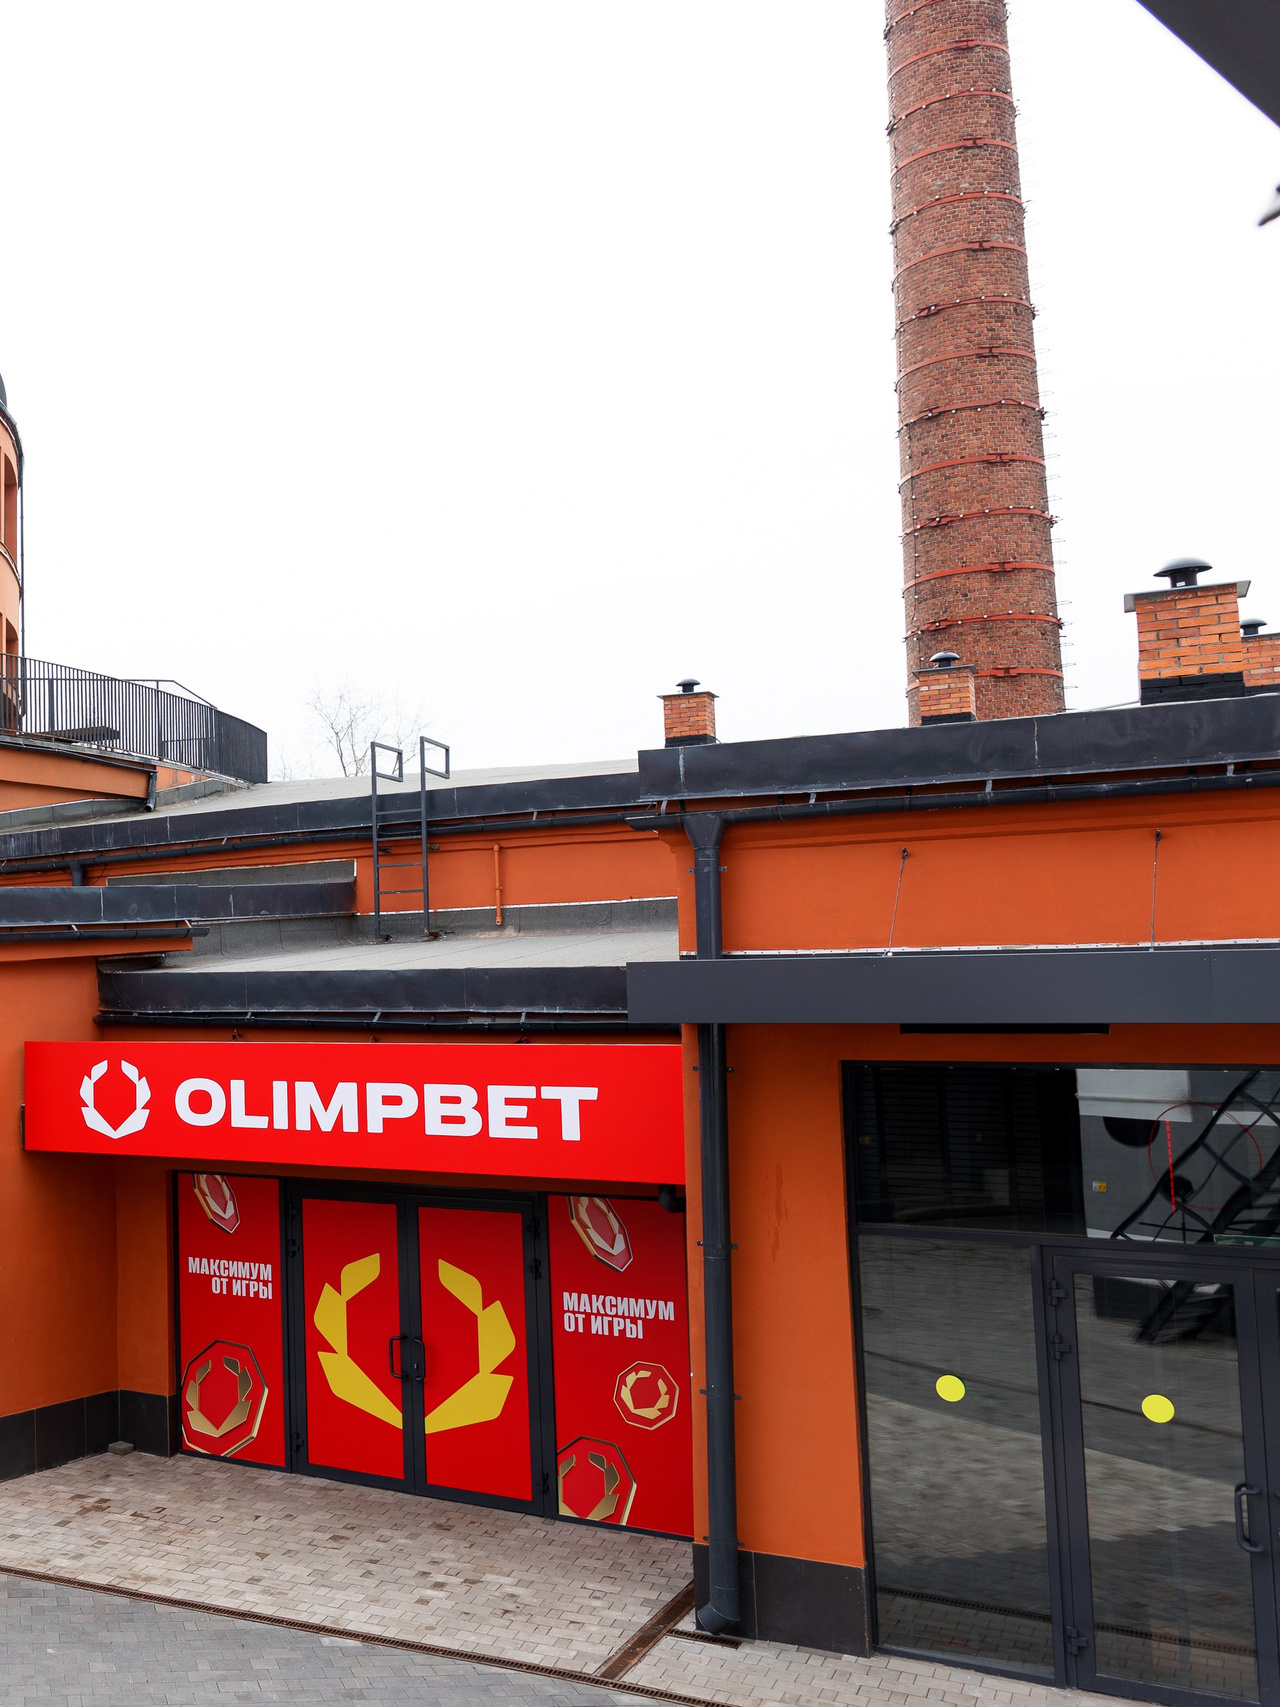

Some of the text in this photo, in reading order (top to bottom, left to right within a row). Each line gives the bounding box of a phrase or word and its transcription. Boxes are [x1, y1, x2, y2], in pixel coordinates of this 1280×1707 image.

[174, 1077, 599, 1142] OLIMPBET
[188, 1256, 272, 1281] МАКСИМУМ
[211, 1277, 273, 1300] ОТ ИГРЫ
[562, 1291, 675, 1321] МАКСИМУМ
[563, 1312, 644, 1340] ОТ ИГРЫ
